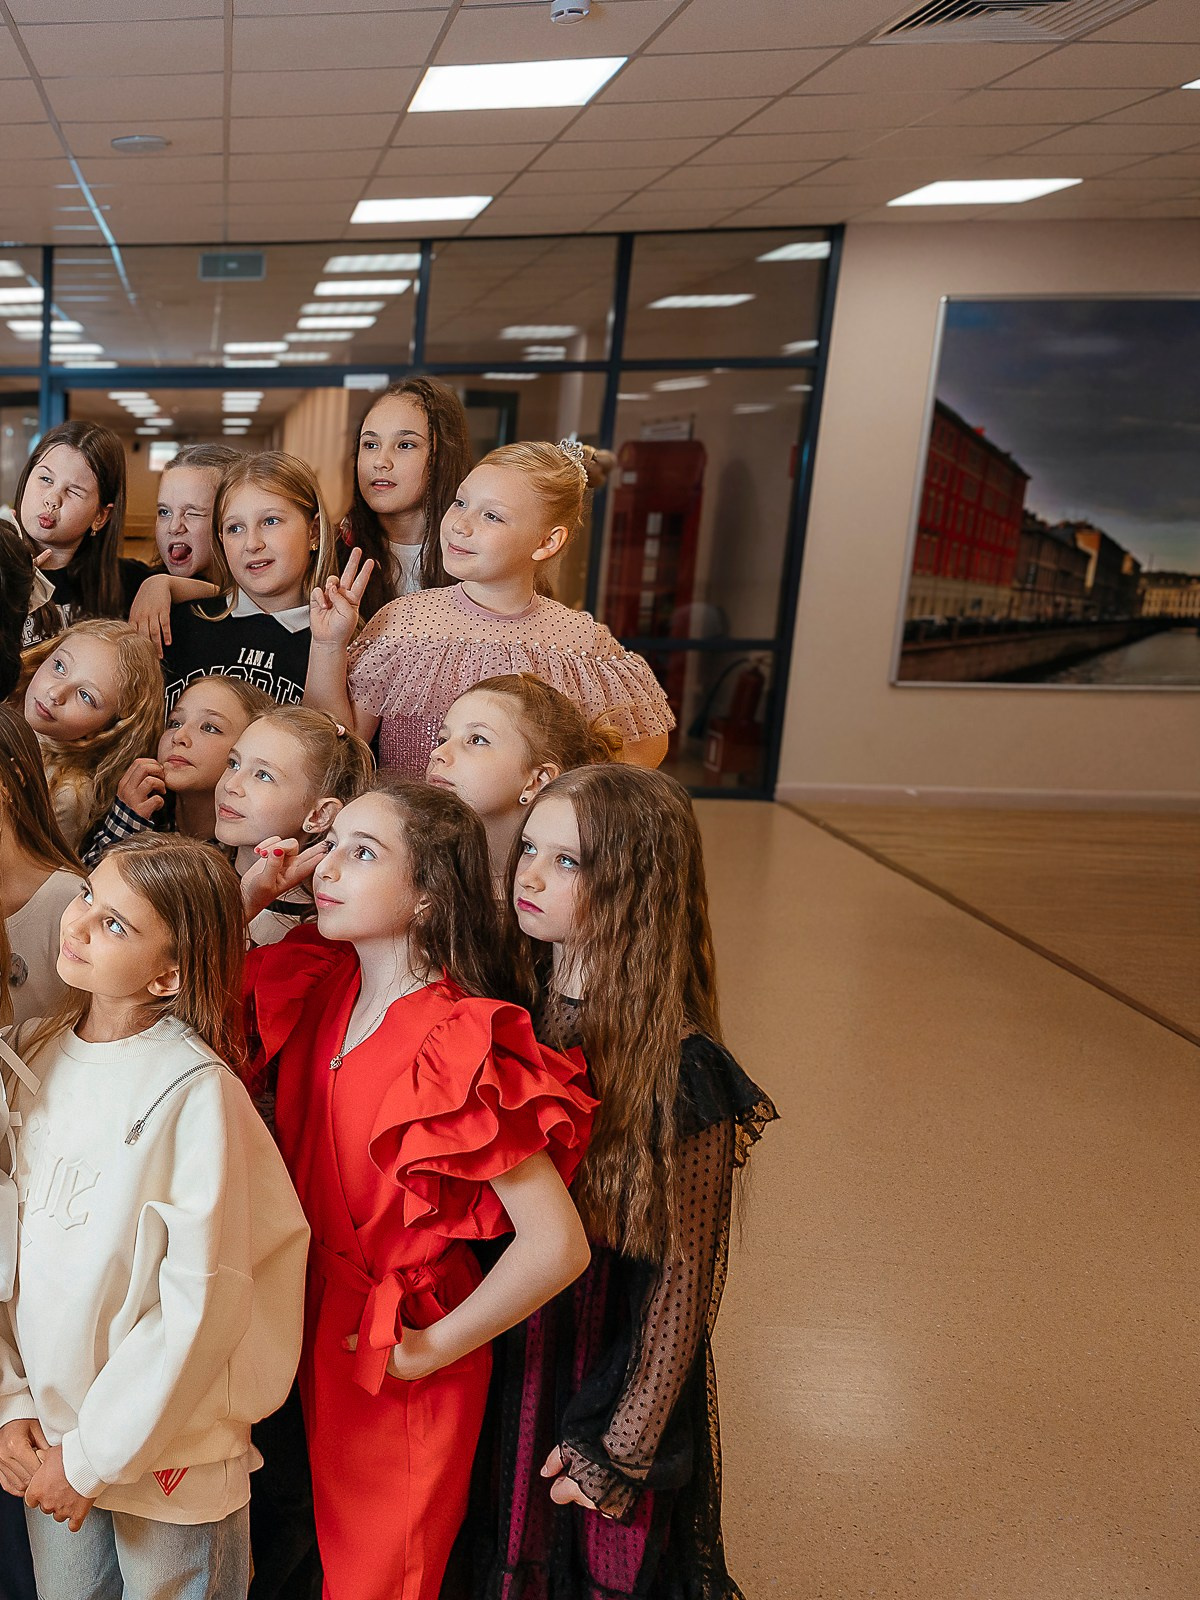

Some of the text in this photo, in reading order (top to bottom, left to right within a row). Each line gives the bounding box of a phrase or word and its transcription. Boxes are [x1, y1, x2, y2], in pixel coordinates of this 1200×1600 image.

[237, 647, 275, 670] I AM A
